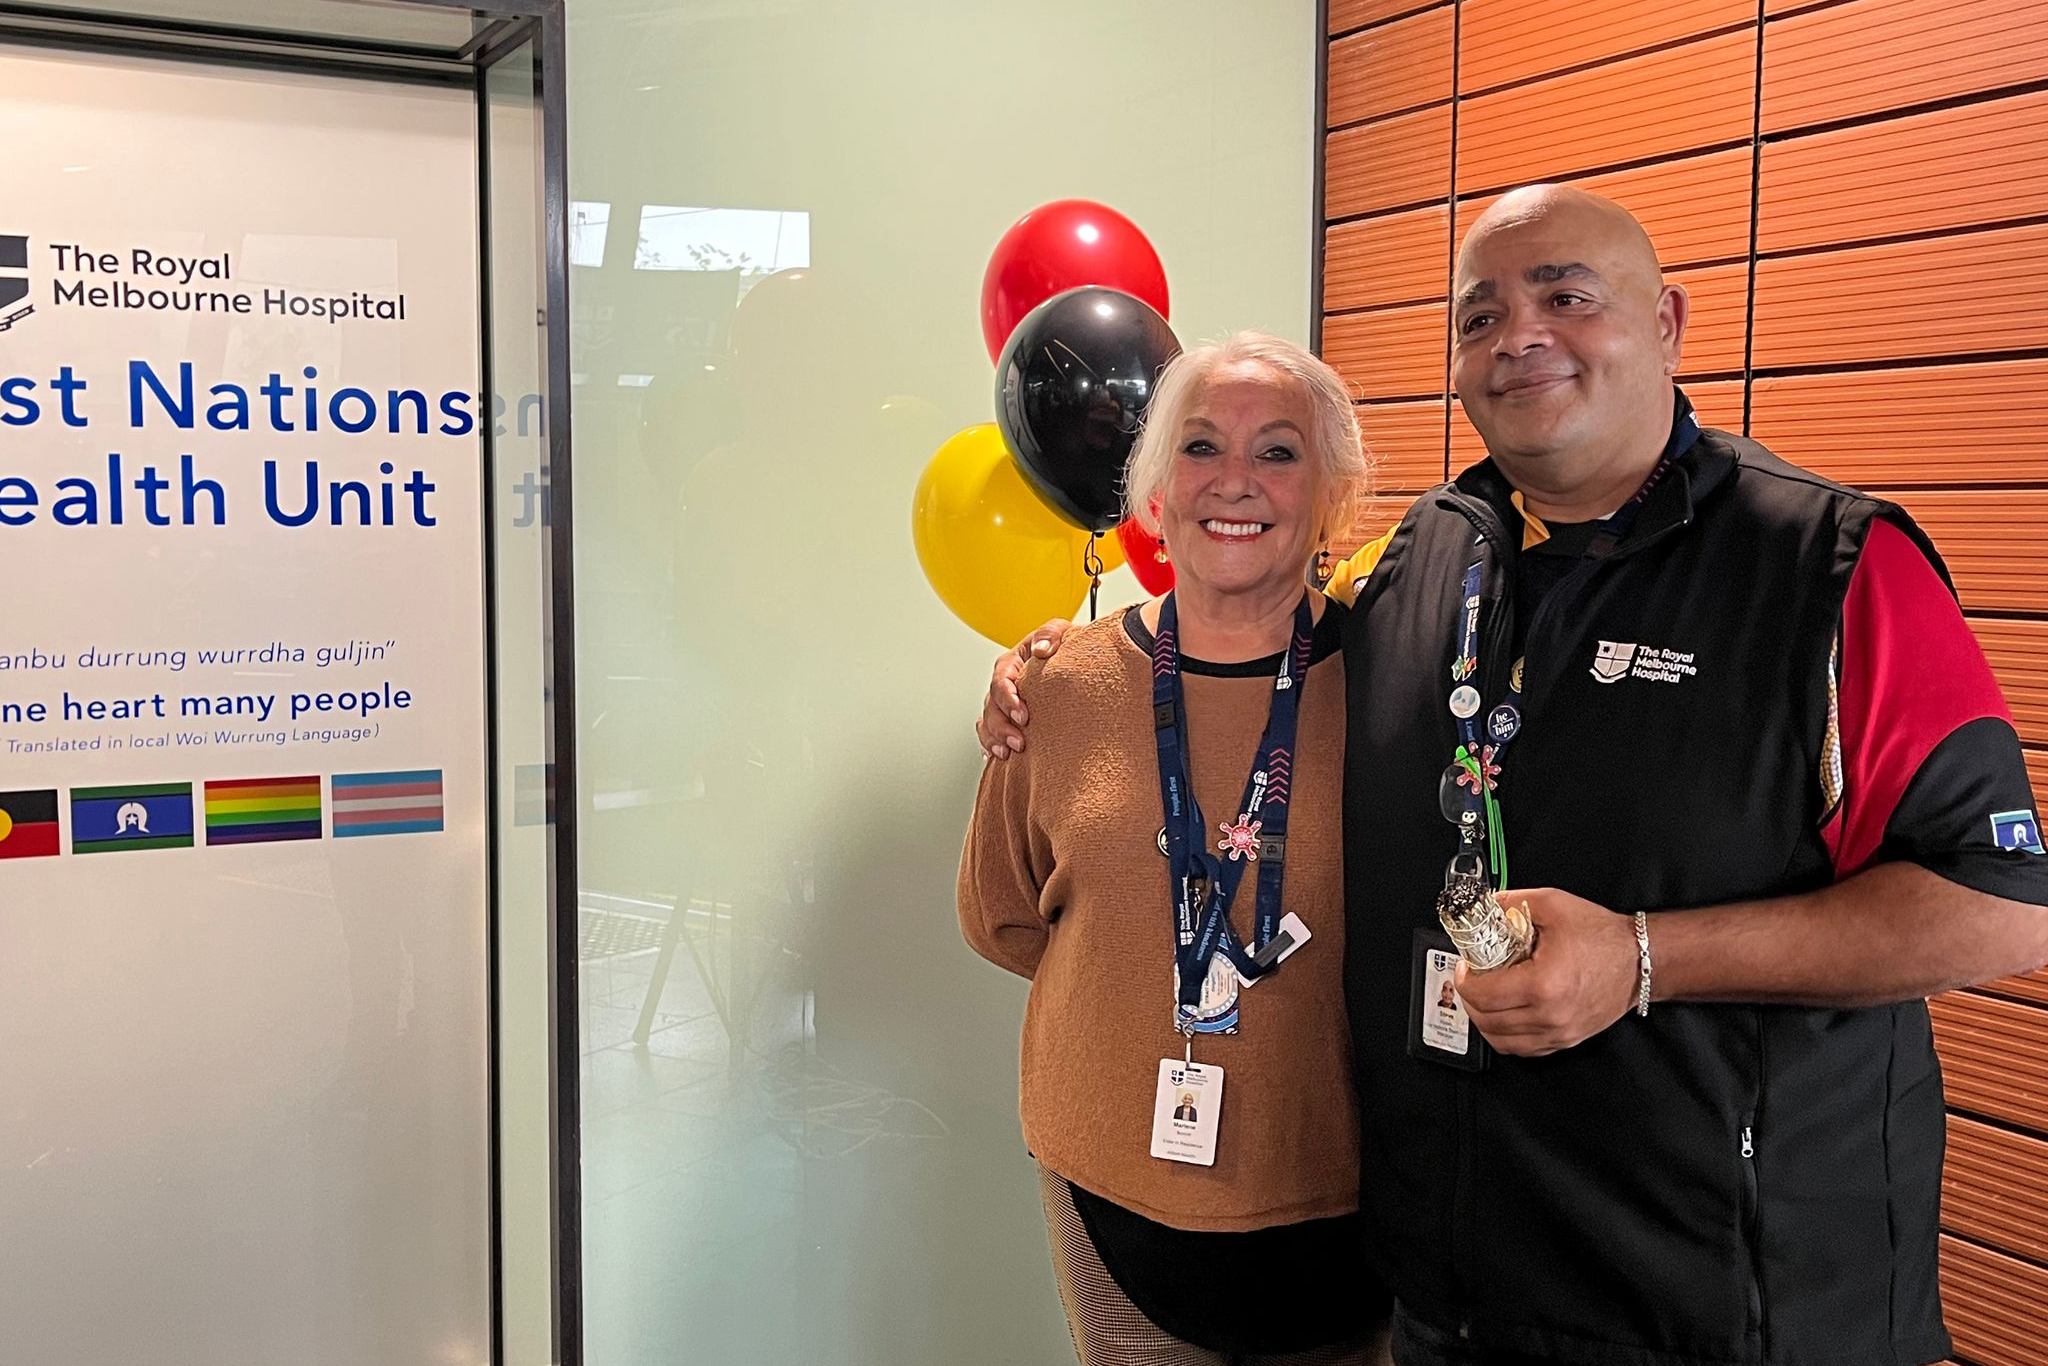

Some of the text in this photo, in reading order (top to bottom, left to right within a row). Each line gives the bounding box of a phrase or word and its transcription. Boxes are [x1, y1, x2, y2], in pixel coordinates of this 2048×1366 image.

[50, 244, 230, 285] The Royal
[54, 279, 405, 325] Melbourne Hospital
[128, 360, 474, 436] Nations
[0, 453, 437, 527] ealth Unit
[78, 645, 186, 672] durrung
[198, 641, 305, 665] wurrdha
[1635, 656, 1697, 676] Melbourne
[1638, 645, 1695, 664] The Royal
[1631, 667, 1681, 683] Hospital
[3, 681, 412, 723] ne heart many people
[7, 736, 101, 753] Translated
[108, 735, 123, 749] in
[129, 733, 170, 748] local
[175, 731, 208, 746] Woi
[214, 730, 286, 747] Wurrung
